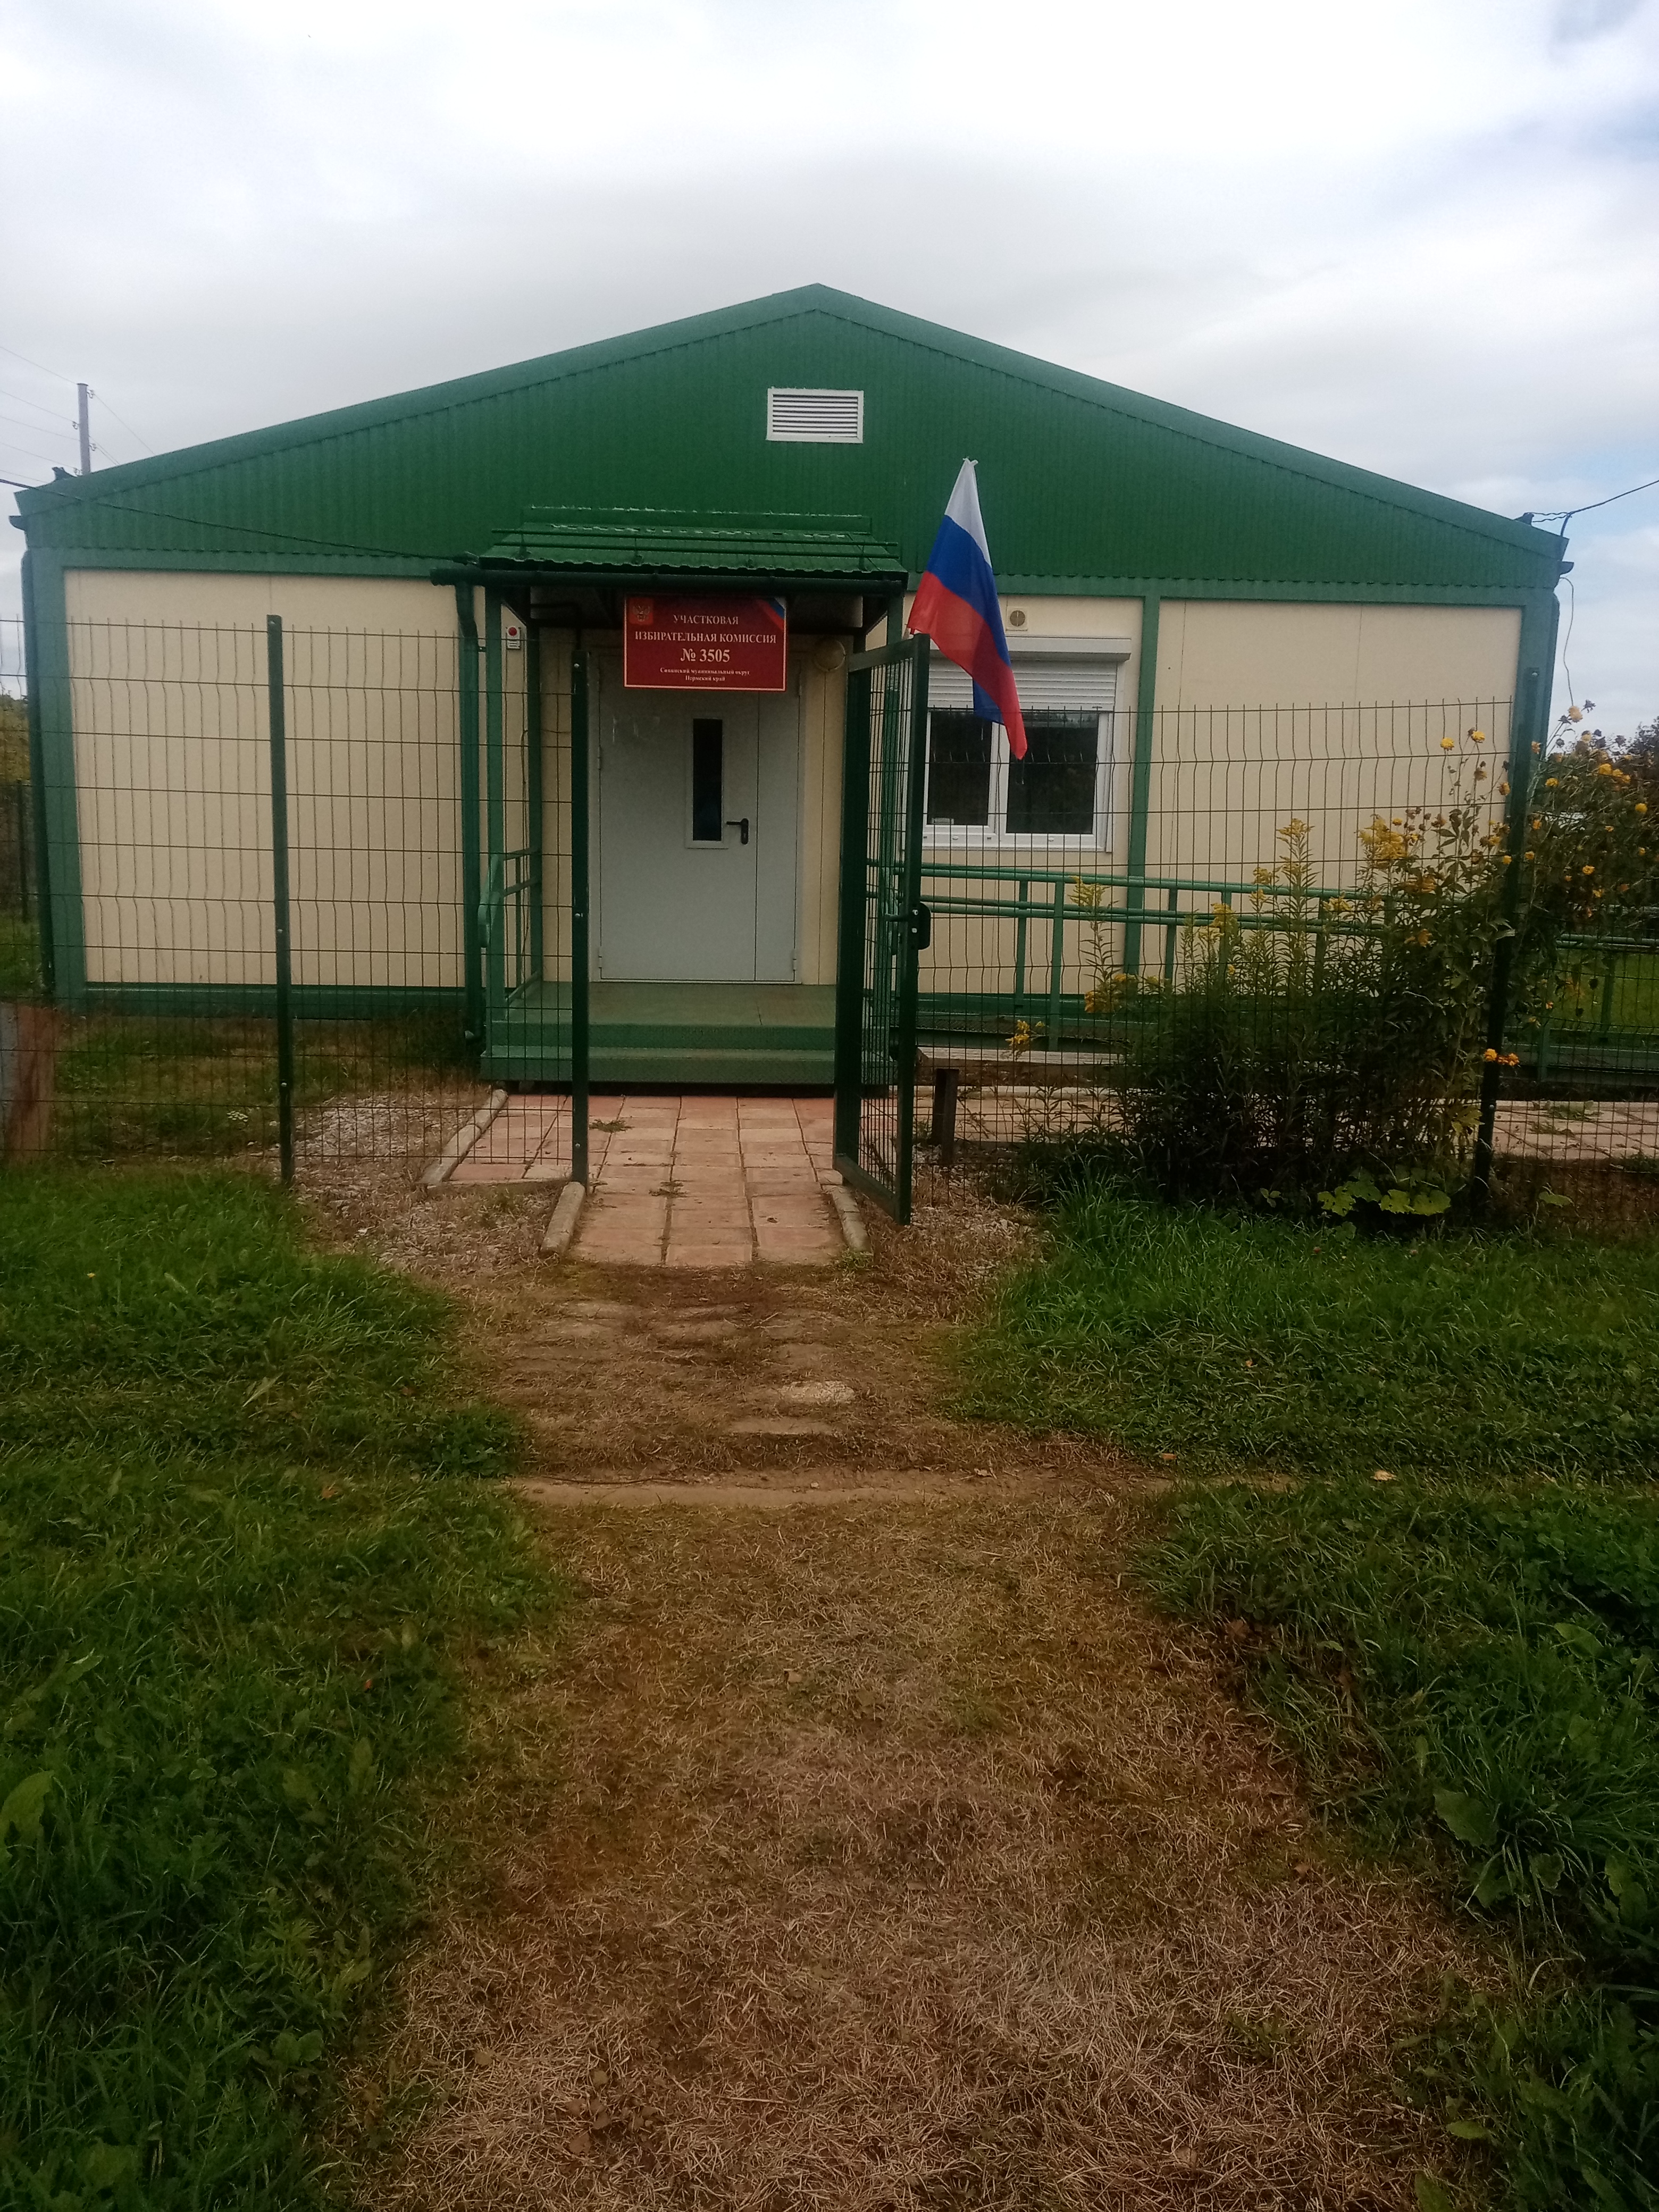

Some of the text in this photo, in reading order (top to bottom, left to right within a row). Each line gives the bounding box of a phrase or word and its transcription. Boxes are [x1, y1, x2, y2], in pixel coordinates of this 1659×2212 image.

[673, 615, 739, 625] УЧАСТКОВАЯ
[635, 631, 776, 644] ИЗБИРАТЕЛЬНАЯ КОМИССИЯ
[680, 648, 730, 663] № 3505
